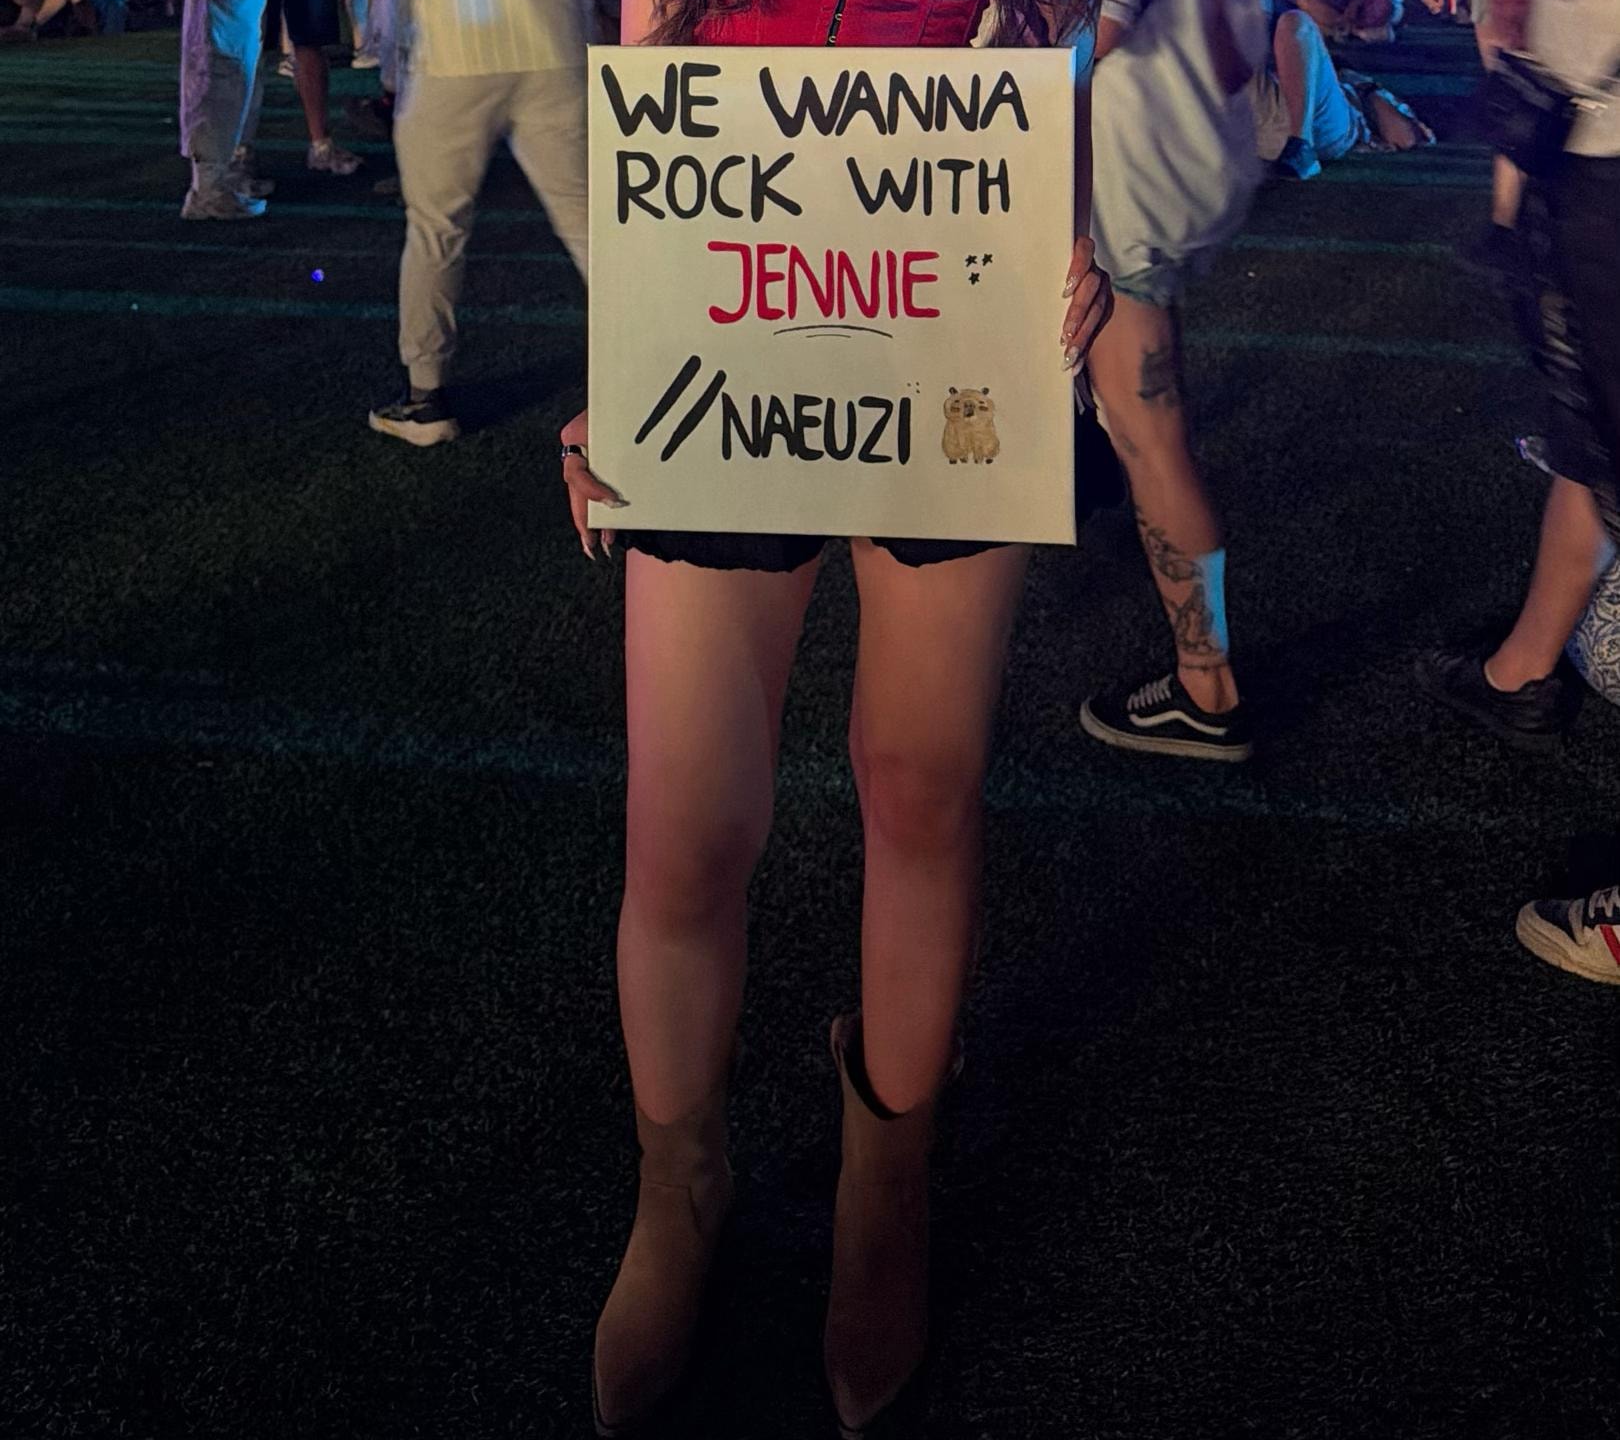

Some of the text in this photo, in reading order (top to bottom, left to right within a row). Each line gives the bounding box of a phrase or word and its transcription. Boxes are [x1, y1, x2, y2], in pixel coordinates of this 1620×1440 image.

[602, 62, 1029, 138] WE WANNA
[617, 151, 1010, 224] ROCK WITH
[708, 241, 940, 323] JENNIE
